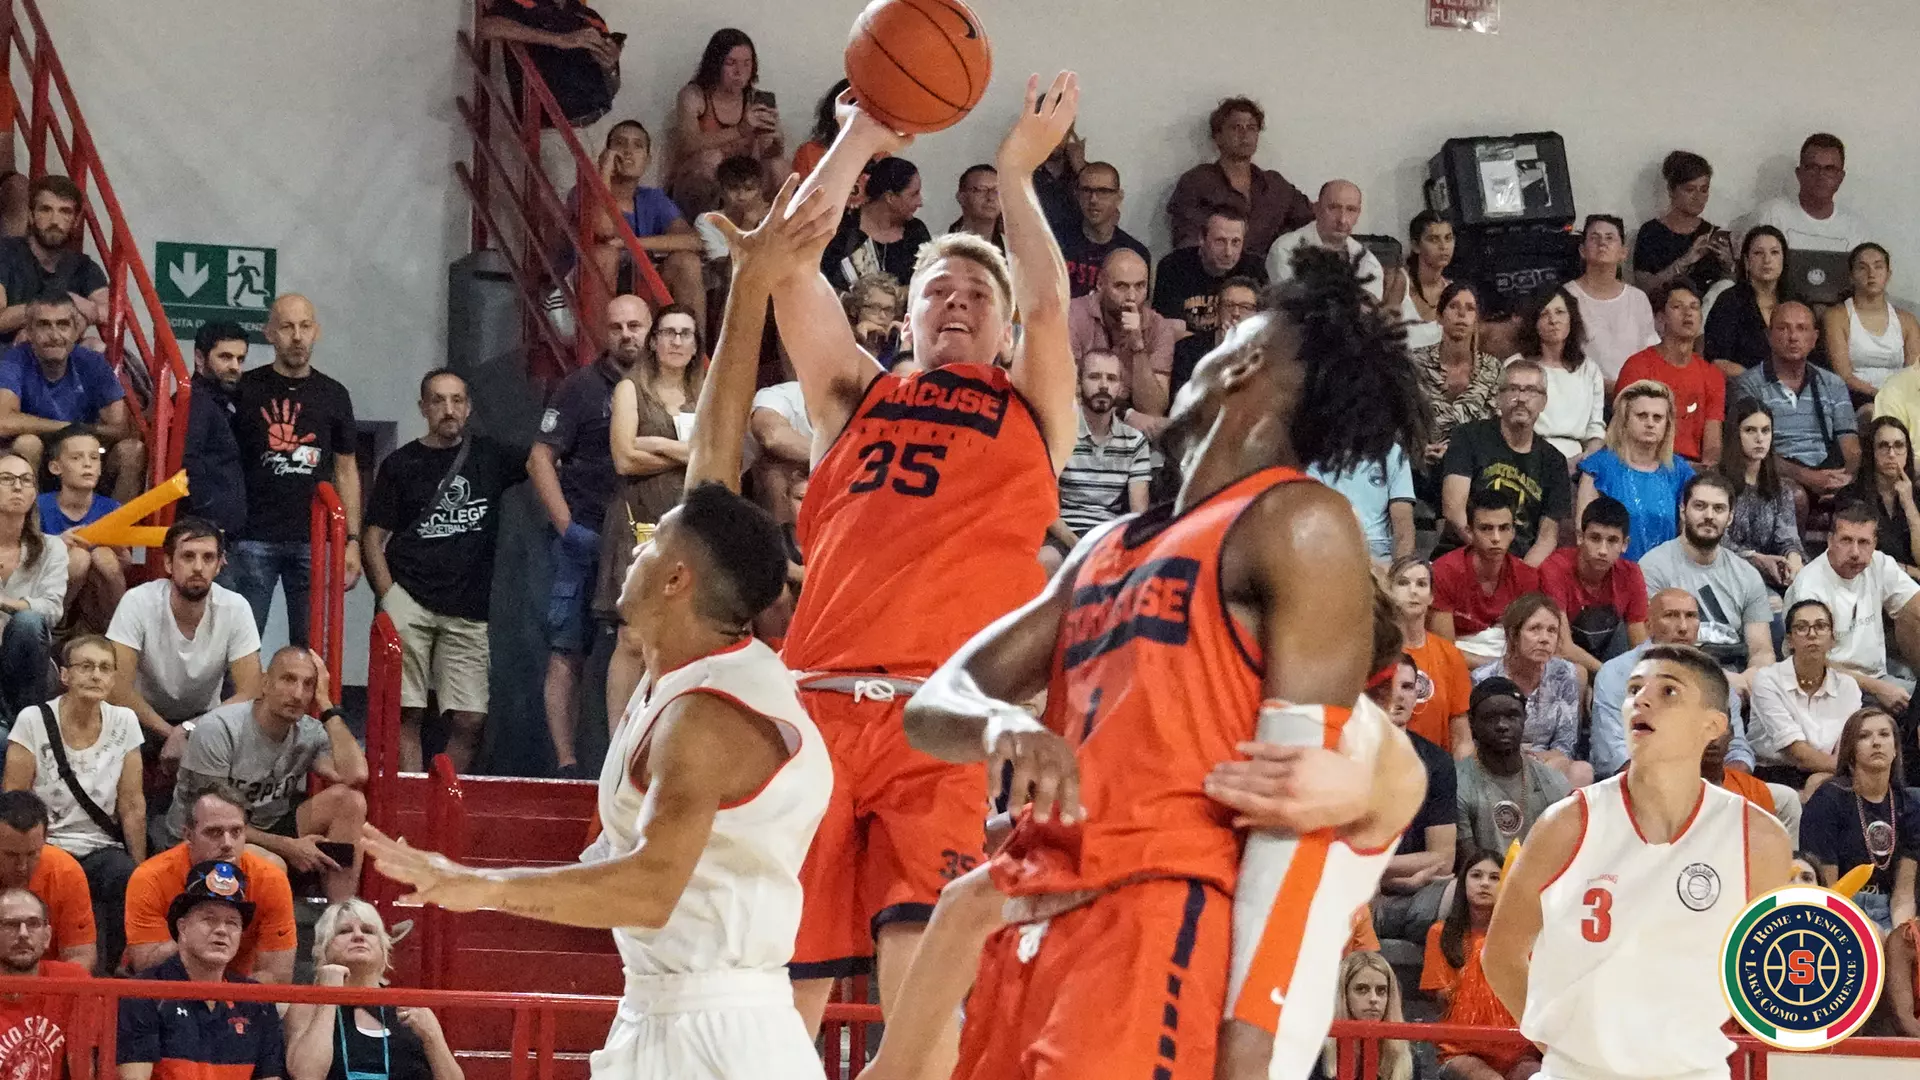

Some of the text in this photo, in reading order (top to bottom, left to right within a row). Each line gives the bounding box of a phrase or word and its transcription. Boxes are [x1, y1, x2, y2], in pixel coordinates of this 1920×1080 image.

[885, 382, 1002, 420] ACUSE
[849, 440, 948, 497] 35
[1581, 888, 1612, 943] 3
[0, 1026, 23, 1069] HIO
